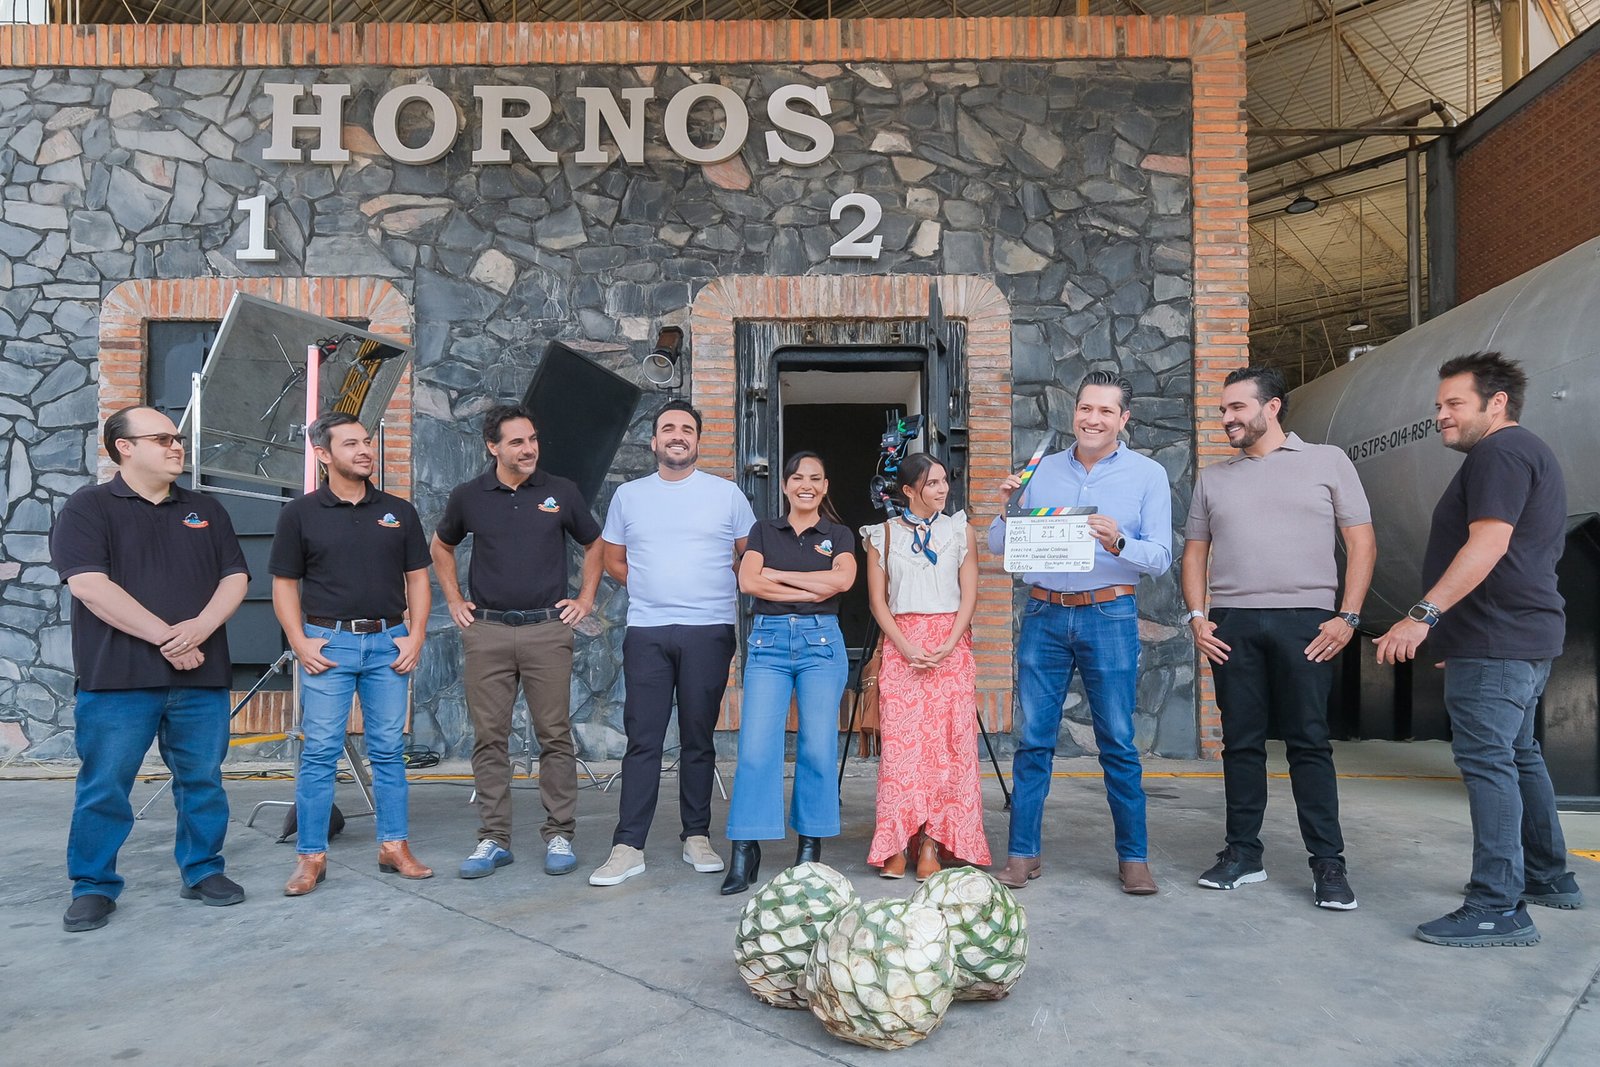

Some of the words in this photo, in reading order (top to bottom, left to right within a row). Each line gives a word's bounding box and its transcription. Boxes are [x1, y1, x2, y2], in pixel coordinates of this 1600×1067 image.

[262, 82, 835, 167] HORNOS
[235, 194, 279, 262] 1
[829, 193, 883, 260] 2
[1076, 530, 1084, 539] 3
